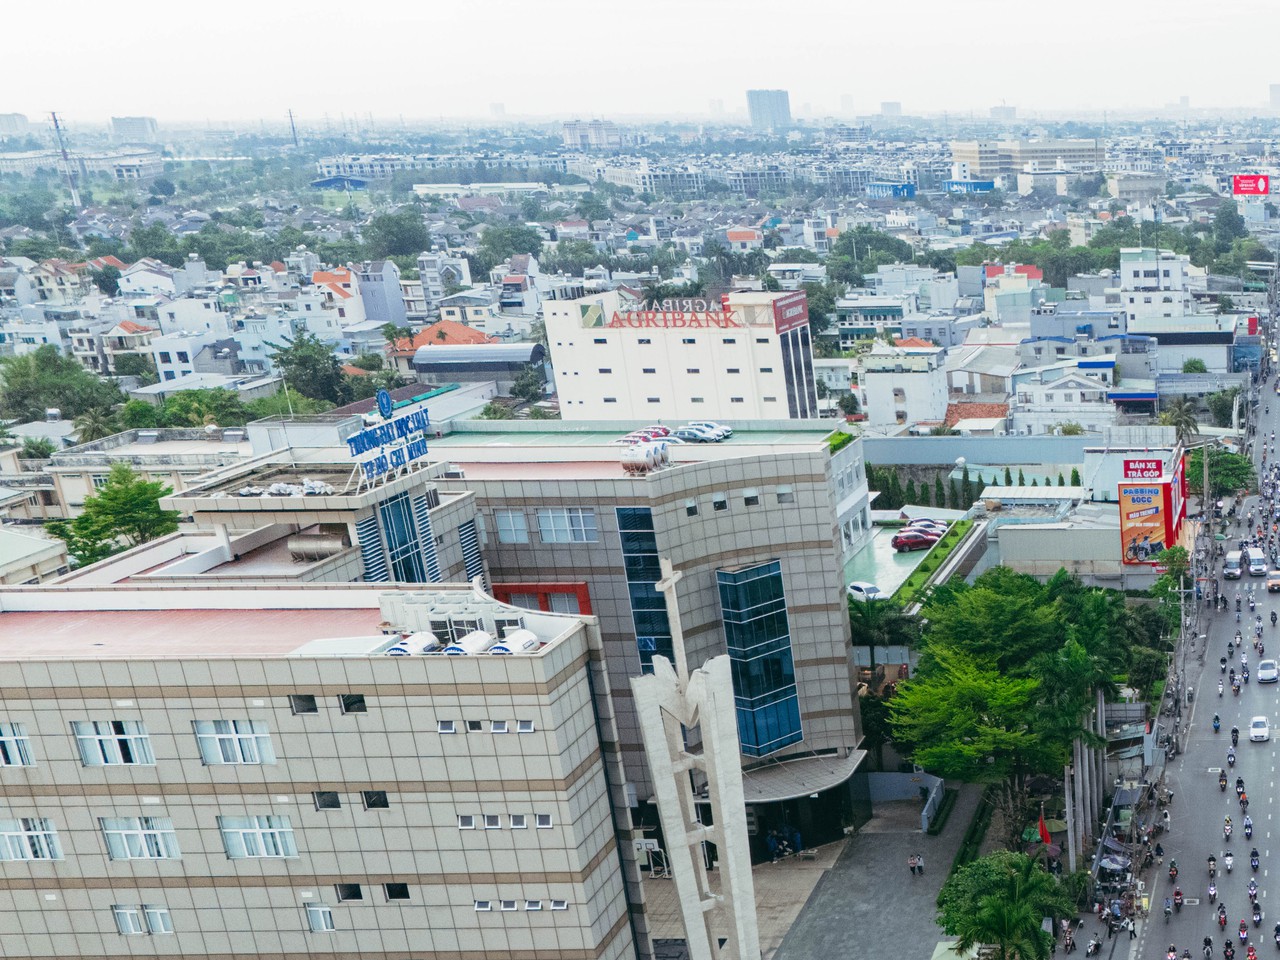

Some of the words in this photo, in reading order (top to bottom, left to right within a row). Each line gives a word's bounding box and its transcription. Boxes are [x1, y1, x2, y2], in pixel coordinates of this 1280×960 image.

[608, 310, 741, 328] AGRIBANK
[1130, 461, 1145, 469] BÁN
[1127, 469, 1142, 478] TRẢ
[1143, 469, 1160, 478] GÓP
